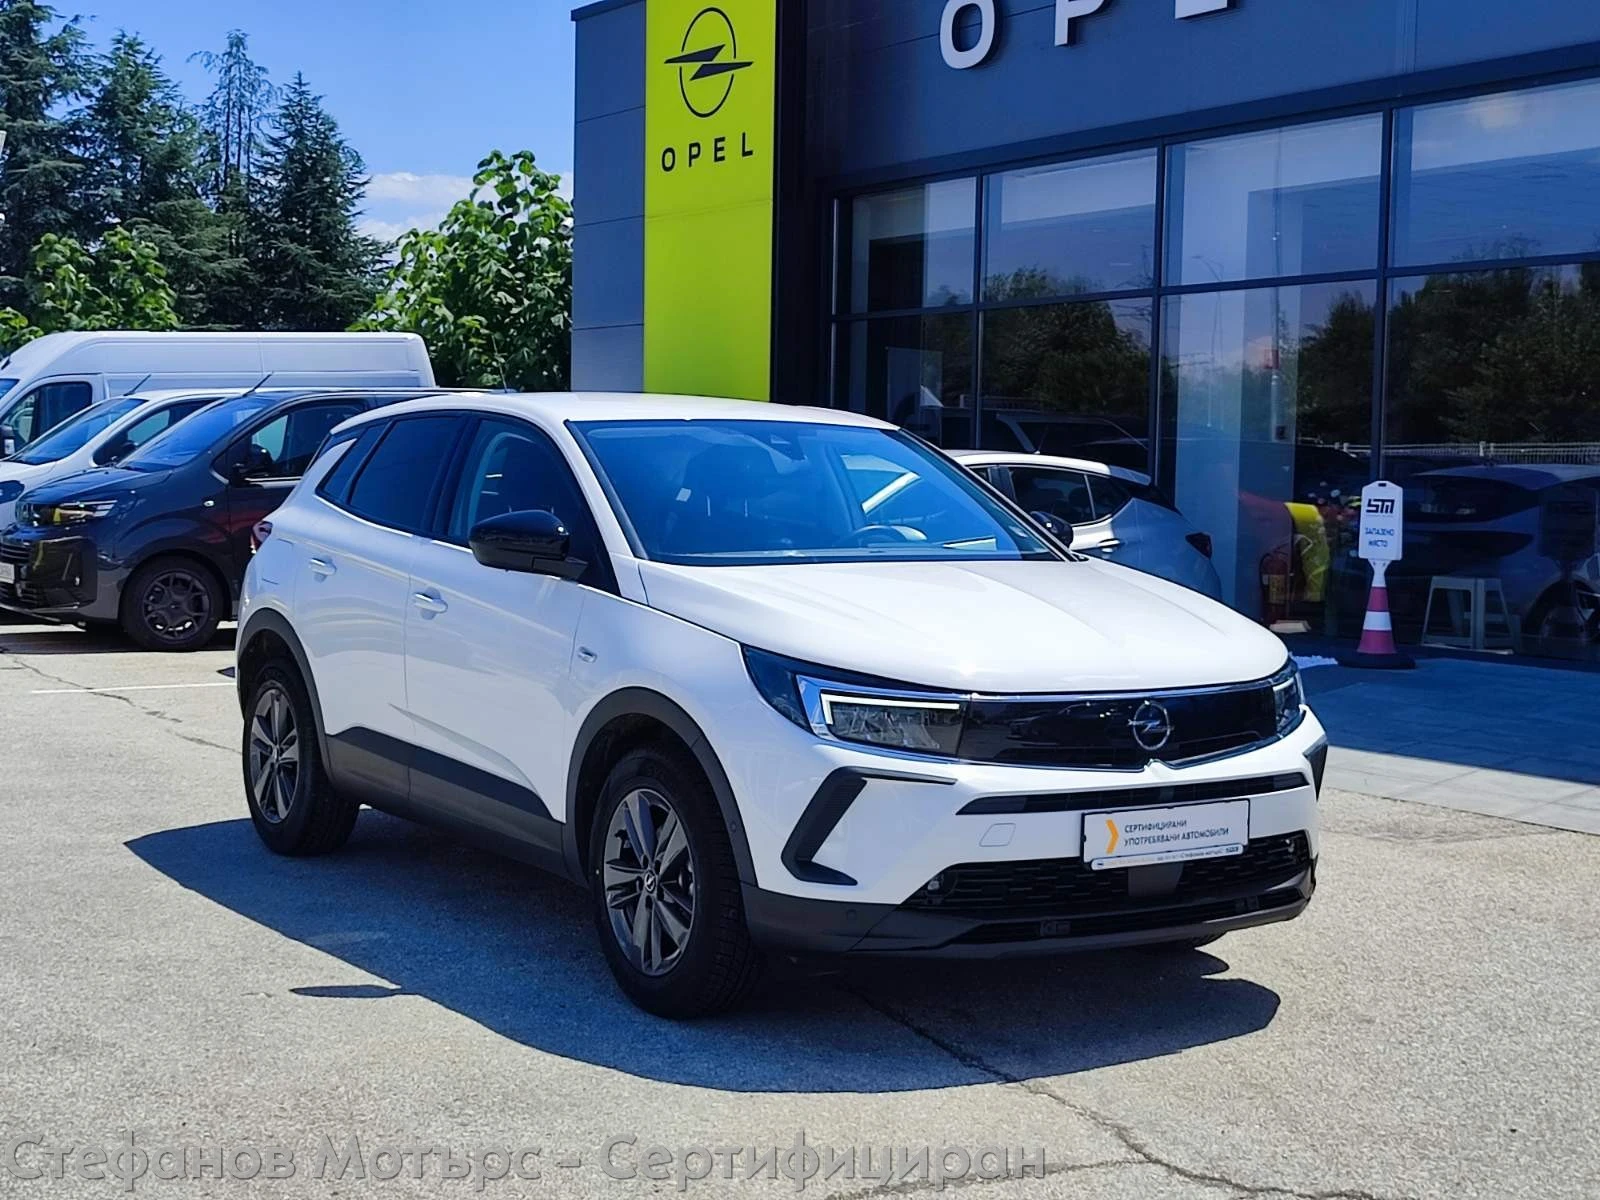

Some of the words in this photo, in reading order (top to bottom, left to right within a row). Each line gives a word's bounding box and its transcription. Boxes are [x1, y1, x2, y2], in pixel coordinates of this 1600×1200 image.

[940, 0, 1229, 69] OP
[662, 131, 753, 172] OPEL
[1124, 819, 1187, 834] СЕРТИФИЦИРАНИ
[1124, 833, 1180, 847] УПОТРЕБЯВАНИ
[1181, 827, 1229, 841] АВТОМОБИЛИ
